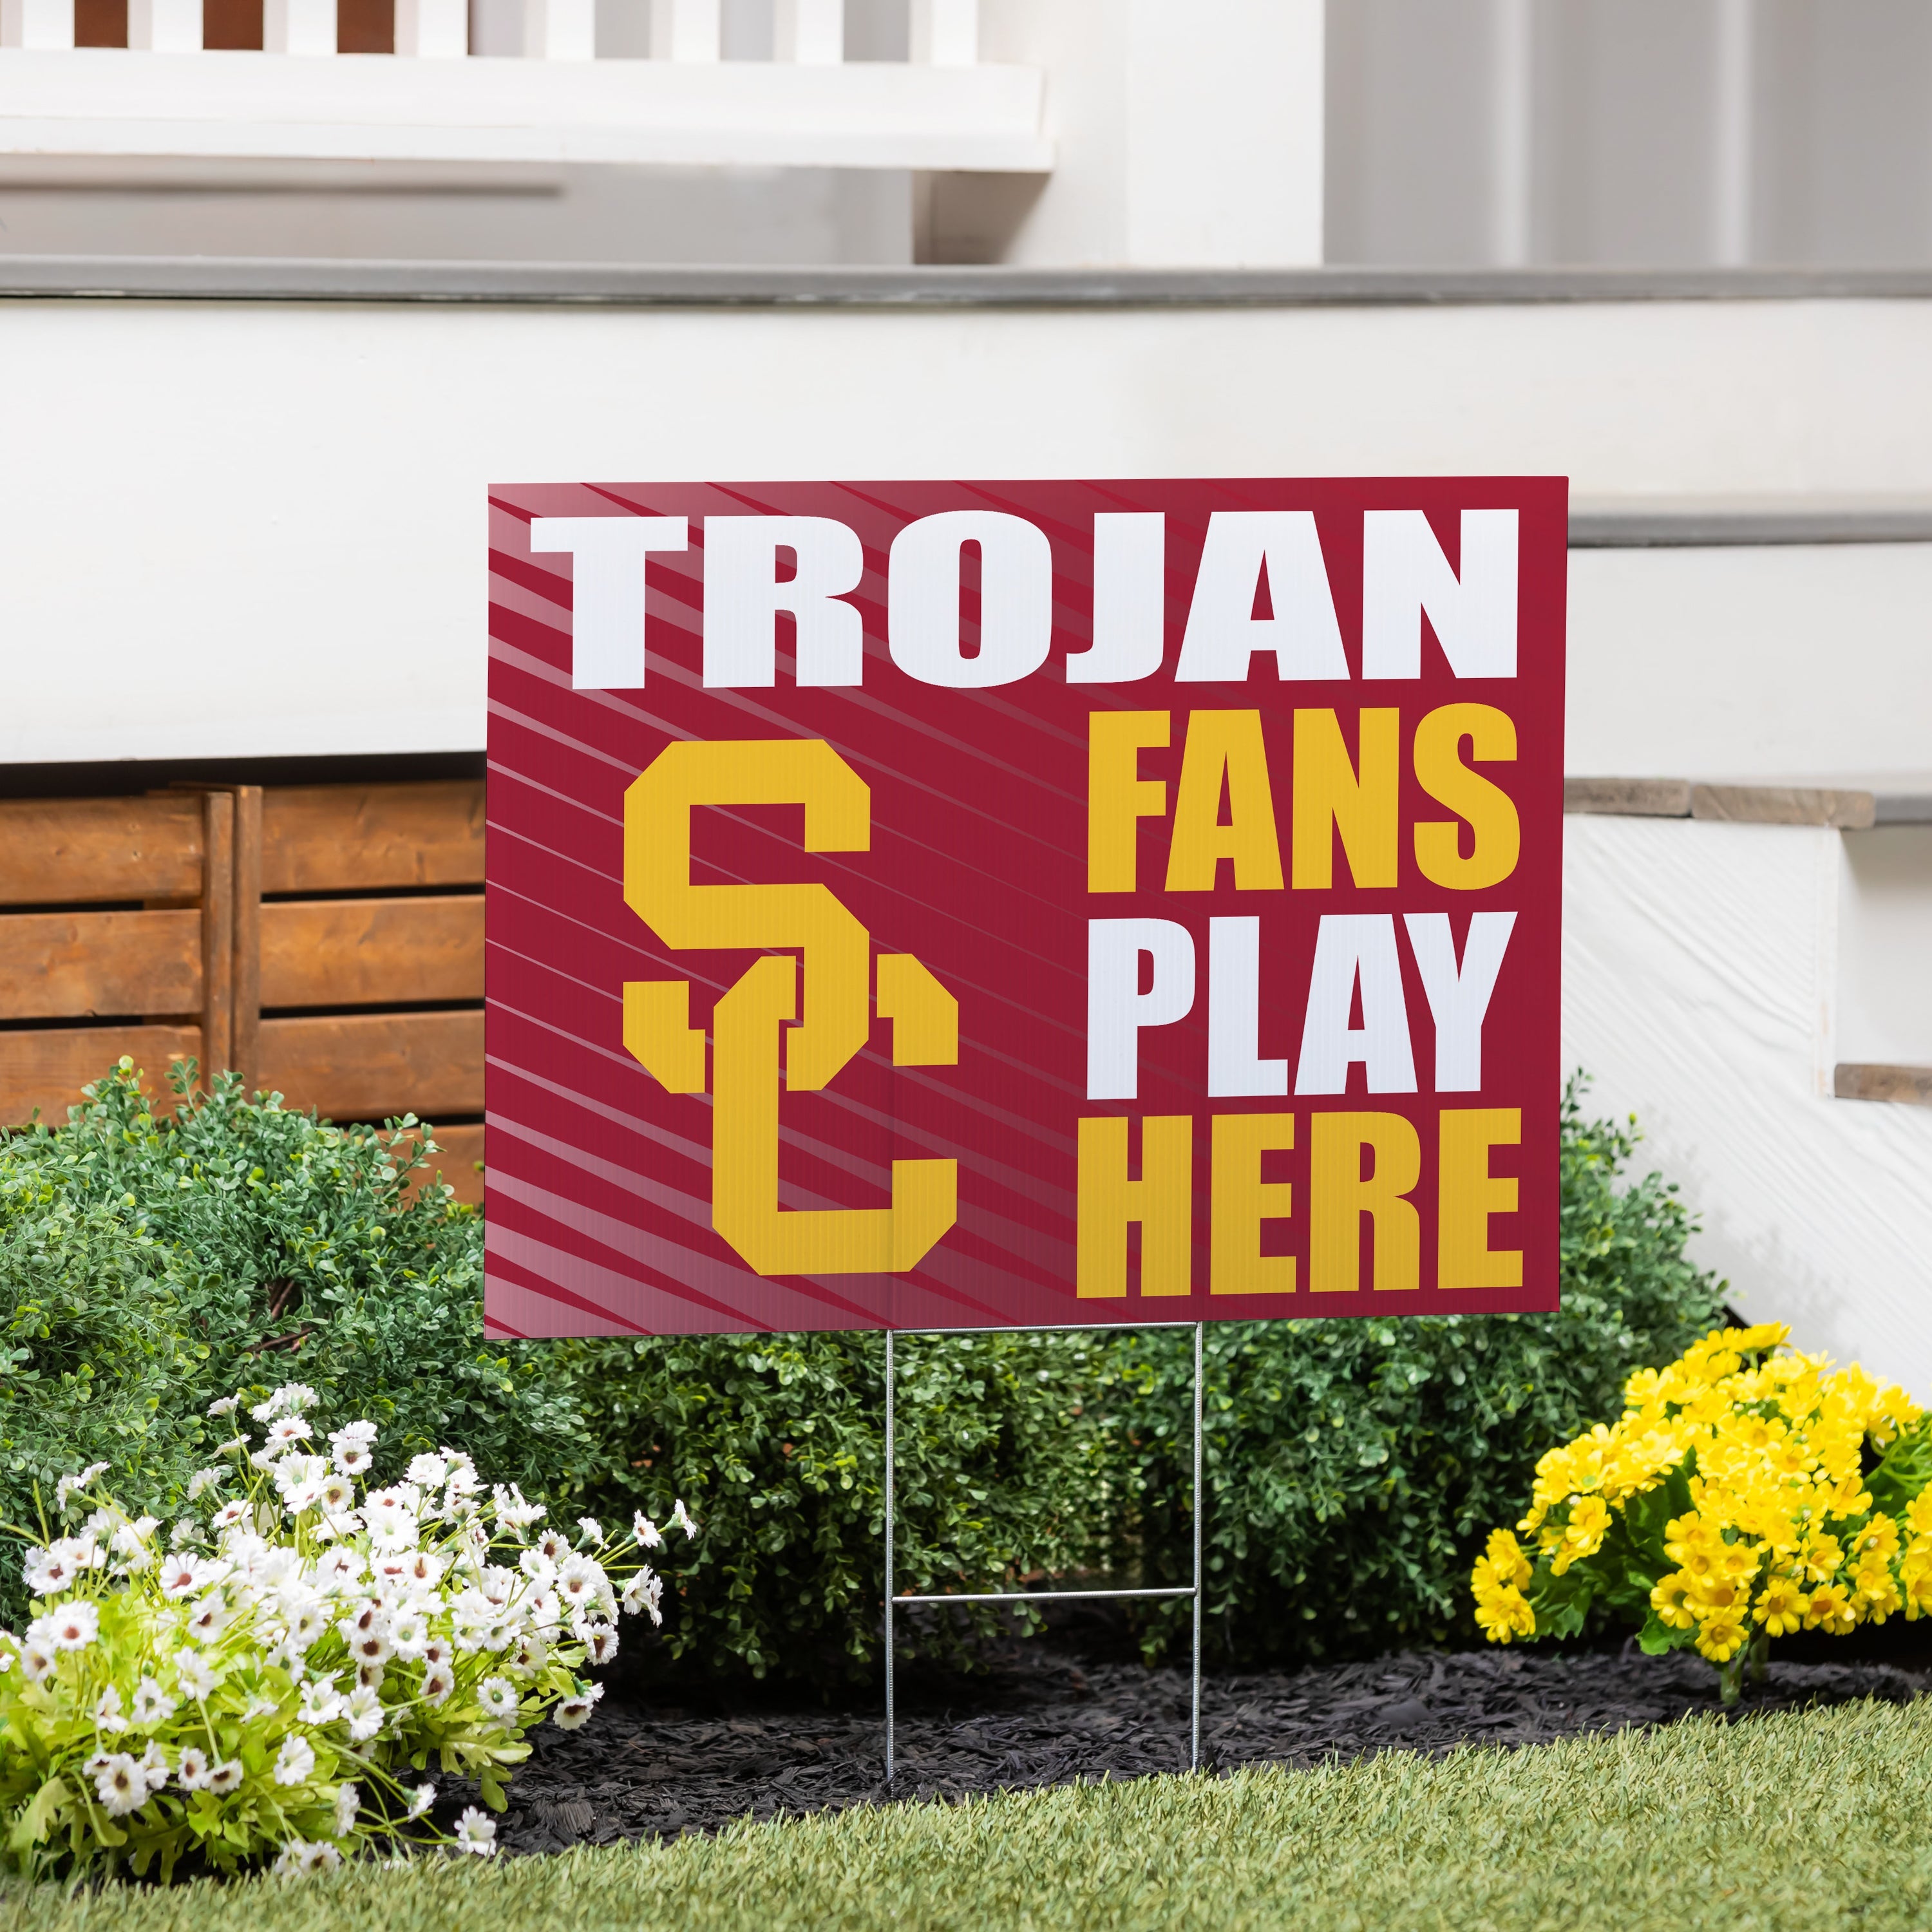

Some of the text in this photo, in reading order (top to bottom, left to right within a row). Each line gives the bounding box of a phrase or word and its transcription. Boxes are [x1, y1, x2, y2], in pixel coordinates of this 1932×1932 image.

[530, 509, 1519, 690] TROJAN
[1088, 703, 1520, 893] FANS
[623, 739, 958, 1276] SC
[1086, 911, 1518, 1100] PLAY
[1077, 1108, 1523, 1298] HERE
